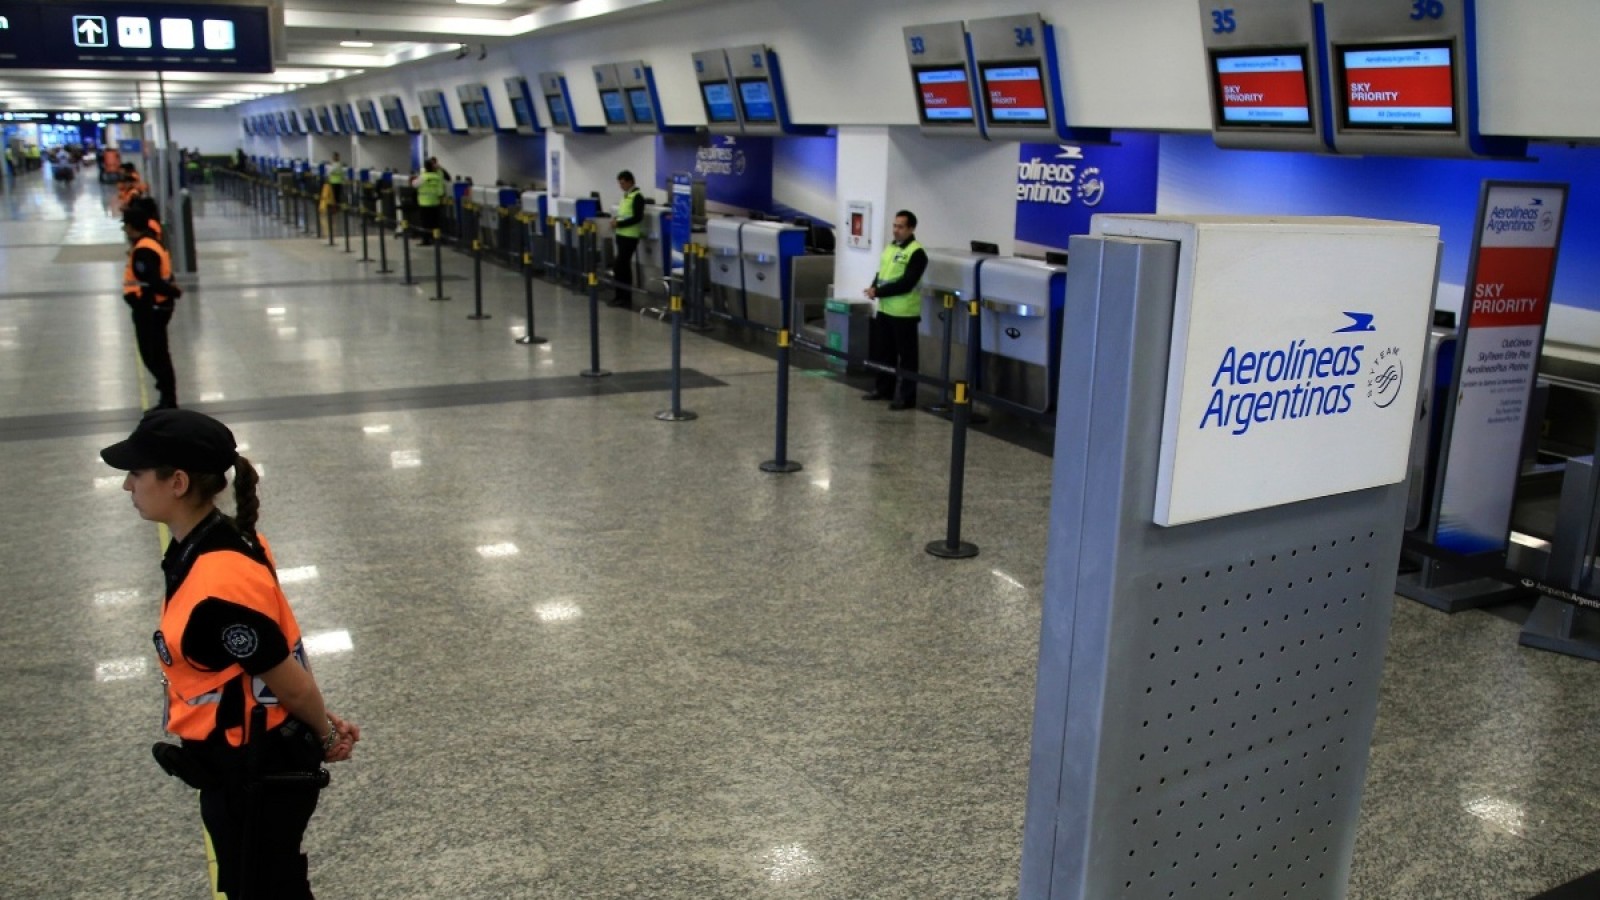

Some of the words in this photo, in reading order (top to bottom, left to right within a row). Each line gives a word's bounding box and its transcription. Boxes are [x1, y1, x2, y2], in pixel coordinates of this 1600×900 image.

[1211, 8, 1237, 33] 35
[1014, 27, 1034, 47] 34
[910, 36, 925, 55] 33
[1223, 85, 1240, 94] SKY
[1351, 83, 1370, 92] SKY
[1225, 93, 1263, 102] PRIORITY
[1351, 92, 1398, 101] PRIORITY
[1487, 219, 1536, 234] Argentinas
[1475, 283, 1504, 298] SKY
[1472, 298, 1537, 314] PRIORITY
[1212, 339, 1364, 387] Aerolíneas
[1199, 382, 1355, 435] Argentinas
